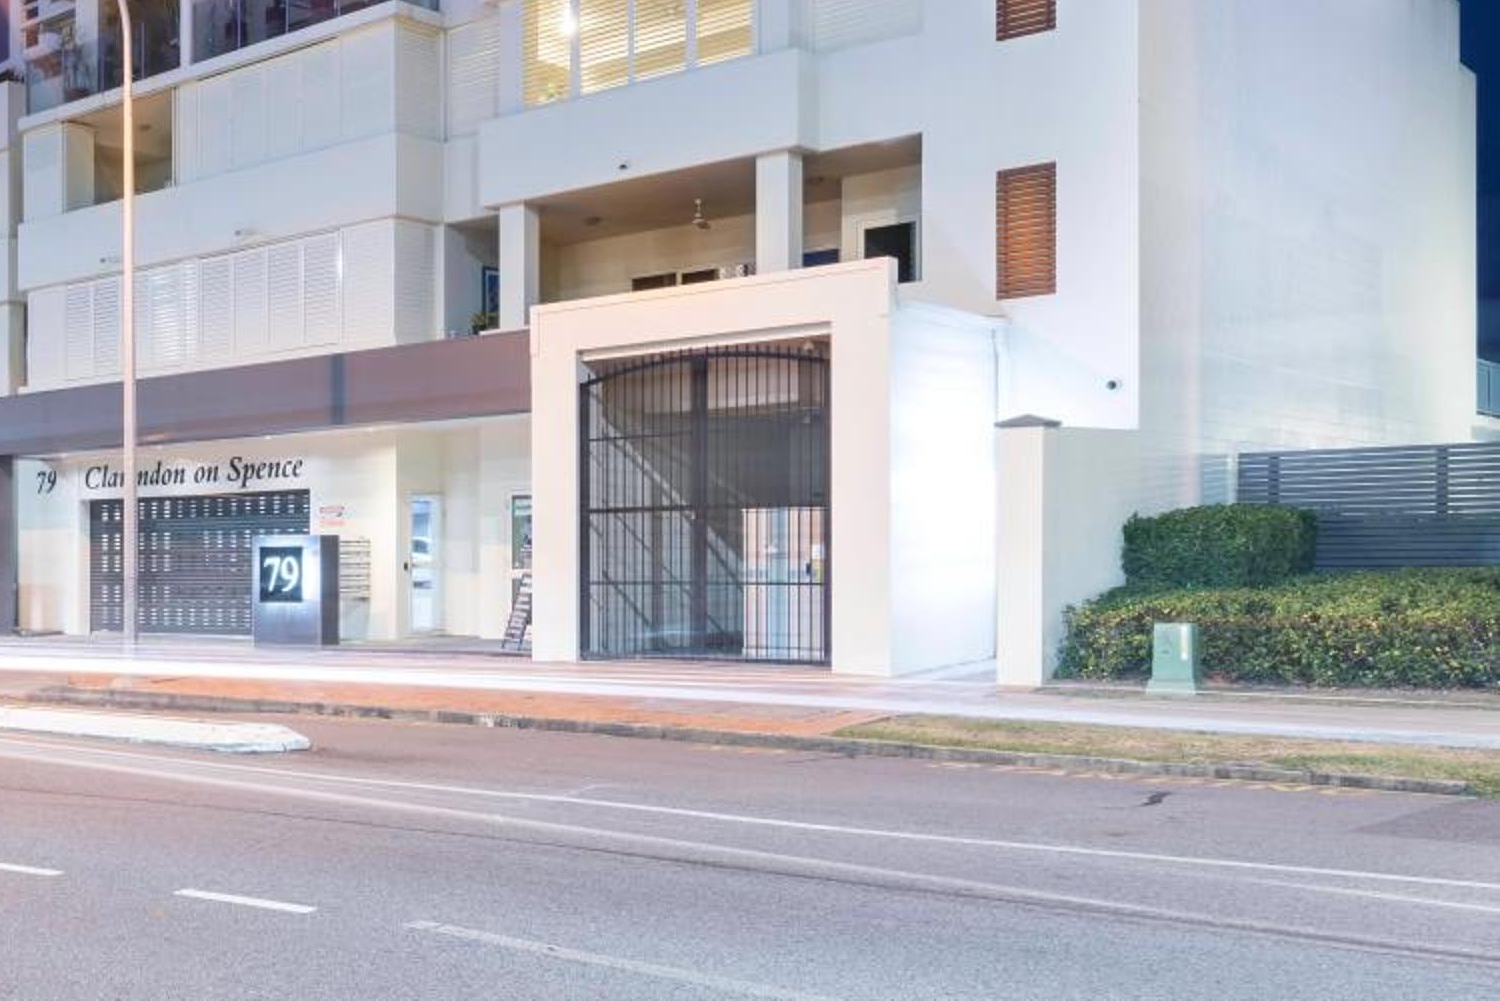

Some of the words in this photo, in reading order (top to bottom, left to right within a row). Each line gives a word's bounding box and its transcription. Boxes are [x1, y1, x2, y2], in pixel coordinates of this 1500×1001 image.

[36, 470, 57, 495] 79
[85, 461, 185, 490] Clarndon
[193, 465, 219, 484] on
[227, 456, 303, 488] Spence
[263, 556, 299, 592] 79
